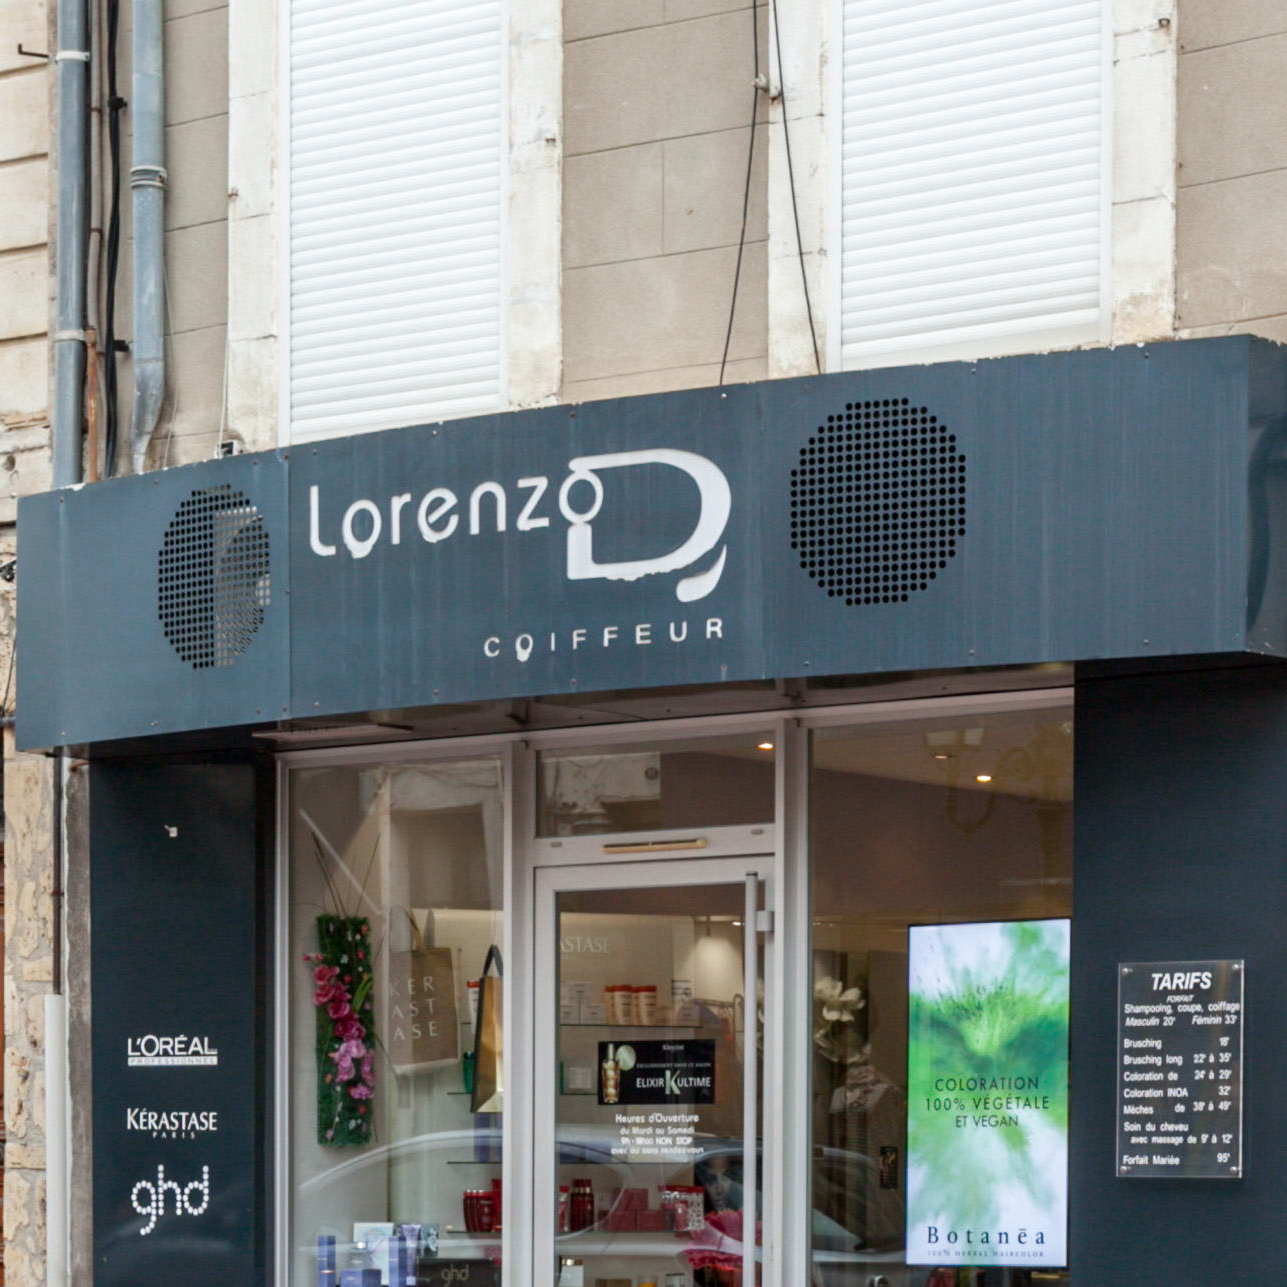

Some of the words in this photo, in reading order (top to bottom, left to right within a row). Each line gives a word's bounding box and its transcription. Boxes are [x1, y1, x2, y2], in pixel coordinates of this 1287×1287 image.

[483, 618, 723, 662] COIFFEUR
[1151, 971, 1212, 991] TARIFS
[1177, 1004, 1204, 1013] coupe,
[1208, 1001, 1241, 1014] coiffage
[1125, 1017, 1160, 1027] Masculin
[1192, 1014, 1222, 1025] Féminin
[127, 1034, 218, 1057] L'ORÉAL
[1123, 1038, 1162, 1050] Brusching
[1123, 1055, 1162, 1066] Brusching
[1166, 1055, 1183, 1066] long
[1208, 1053, 1215, 1063] à
[1123, 1071, 1164, 1082] Coloration
[1167, 1071, 1179, 1081] de
[1208, 1069, 1215, 1080] à
[935, 1076, 1039, 1092] COLORATION
[1123, 1088, 1164, 1098] Coloration
[1167, 1087, 1189, 1097] INOA
[926, 1098, 966, 1112] 100%
[972, 1094, 1049, 1110] VÉGÉTALE
[1174, 1102, 1186, 1113] de
[1207, 1100, 1214, 1111] à
[127, 1107, 218, 1130] KÉRASTASE
[615, 1113, 646, 1123] Heures
[648, 1112, 700, 1123] d'Ouverture
[955, 1115, 967, 1128] ET
[972, 1114, 1018, 1128] VEGAN
[1123, 1121, 1141, 1132] Soin
[1145, 1121, 1156, 1131] du
[1160, 1121, 1188, 1131] cheveu
[153, 1131, 196, 1139] PARIS
[655, 1136, 673, 1145] NON
[1130, 1136, 1148, 1144] avec
[1151, 1135, 1184, 1145] massage
[1187, 1134, 1197, 1144] de
[1211, 1133, 1218, 1144] à
[1123, 1155, 1148, 1166] Forfait
[1152, 1155, 1180, 1166] Mariée
[131, 1164, 210, 1236] ghd
[440, 1263, 470, 1287] ghd
